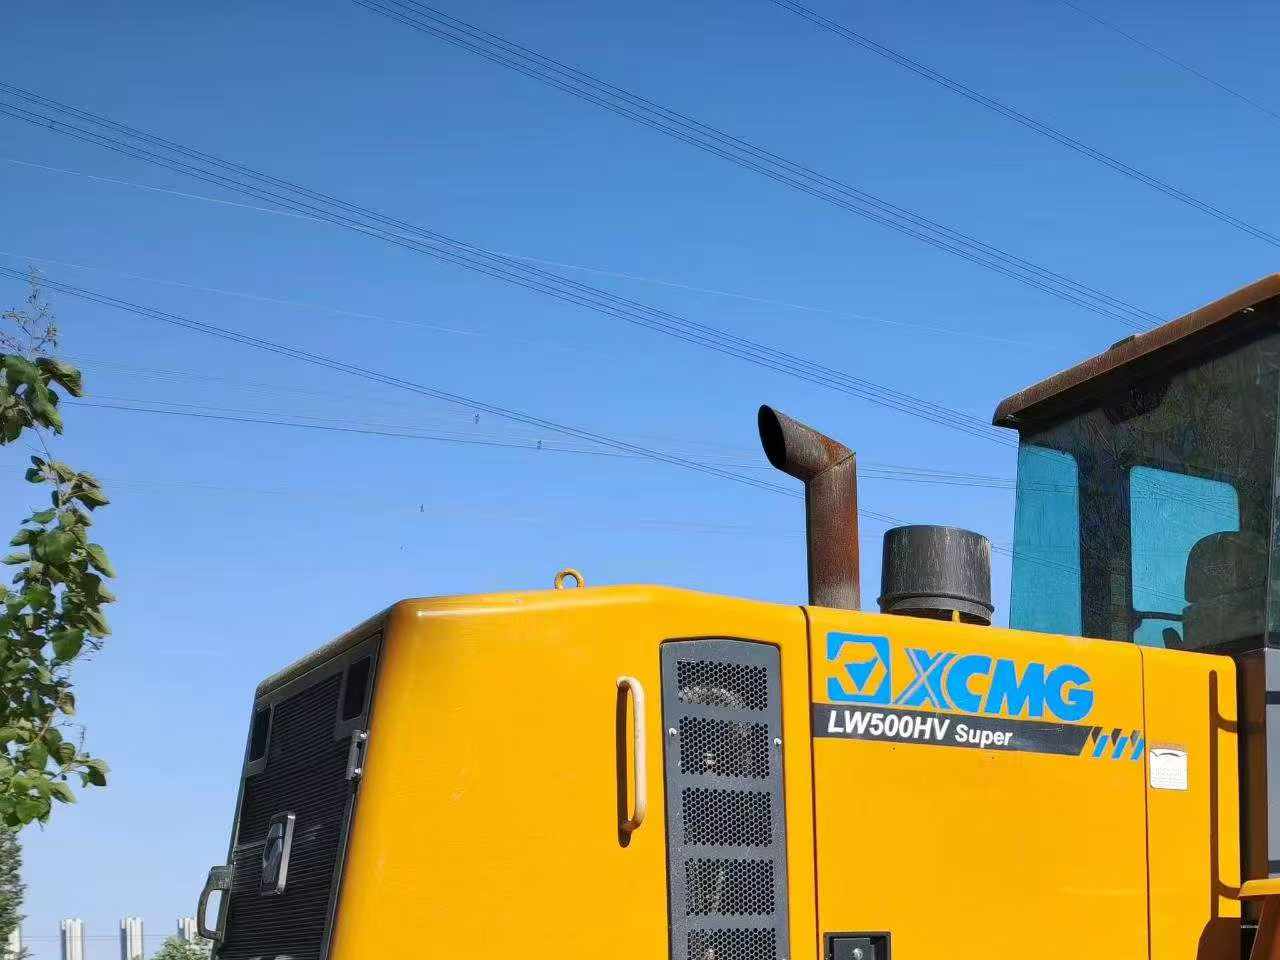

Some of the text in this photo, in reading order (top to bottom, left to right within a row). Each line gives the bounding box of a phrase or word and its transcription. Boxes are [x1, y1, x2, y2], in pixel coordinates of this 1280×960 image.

[896, 647, 1094, 722] XCMG
[827, 710, 1014, 748] LW500HV Super
